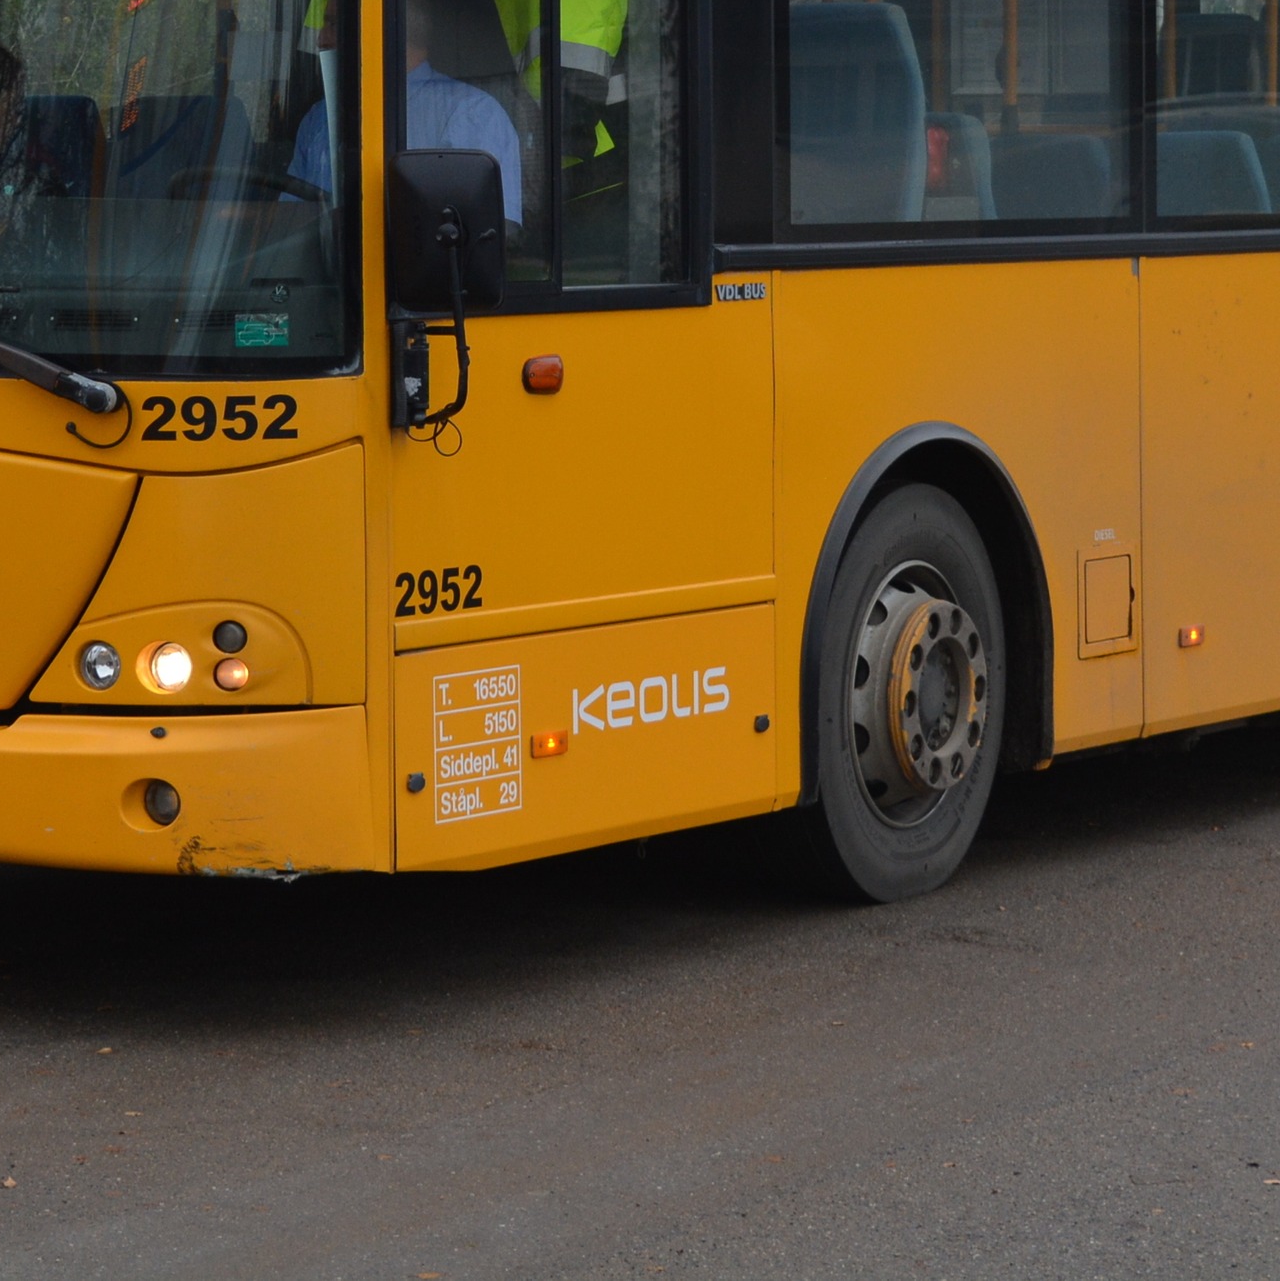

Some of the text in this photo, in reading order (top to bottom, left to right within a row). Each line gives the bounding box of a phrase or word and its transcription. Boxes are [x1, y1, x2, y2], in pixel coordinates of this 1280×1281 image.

[715, 283, 767, 301] VDL BUS
[141, 393, 299, 442] 2952
[395, 564, 483, 617] 2952
[439, 674, 516, 706] T. 16550
[439, 709, 517, 742] L. 5150
[441, 744, 517, 778] Siddepl. 41
[441, 781, 517, 815] Ståpl. 29
